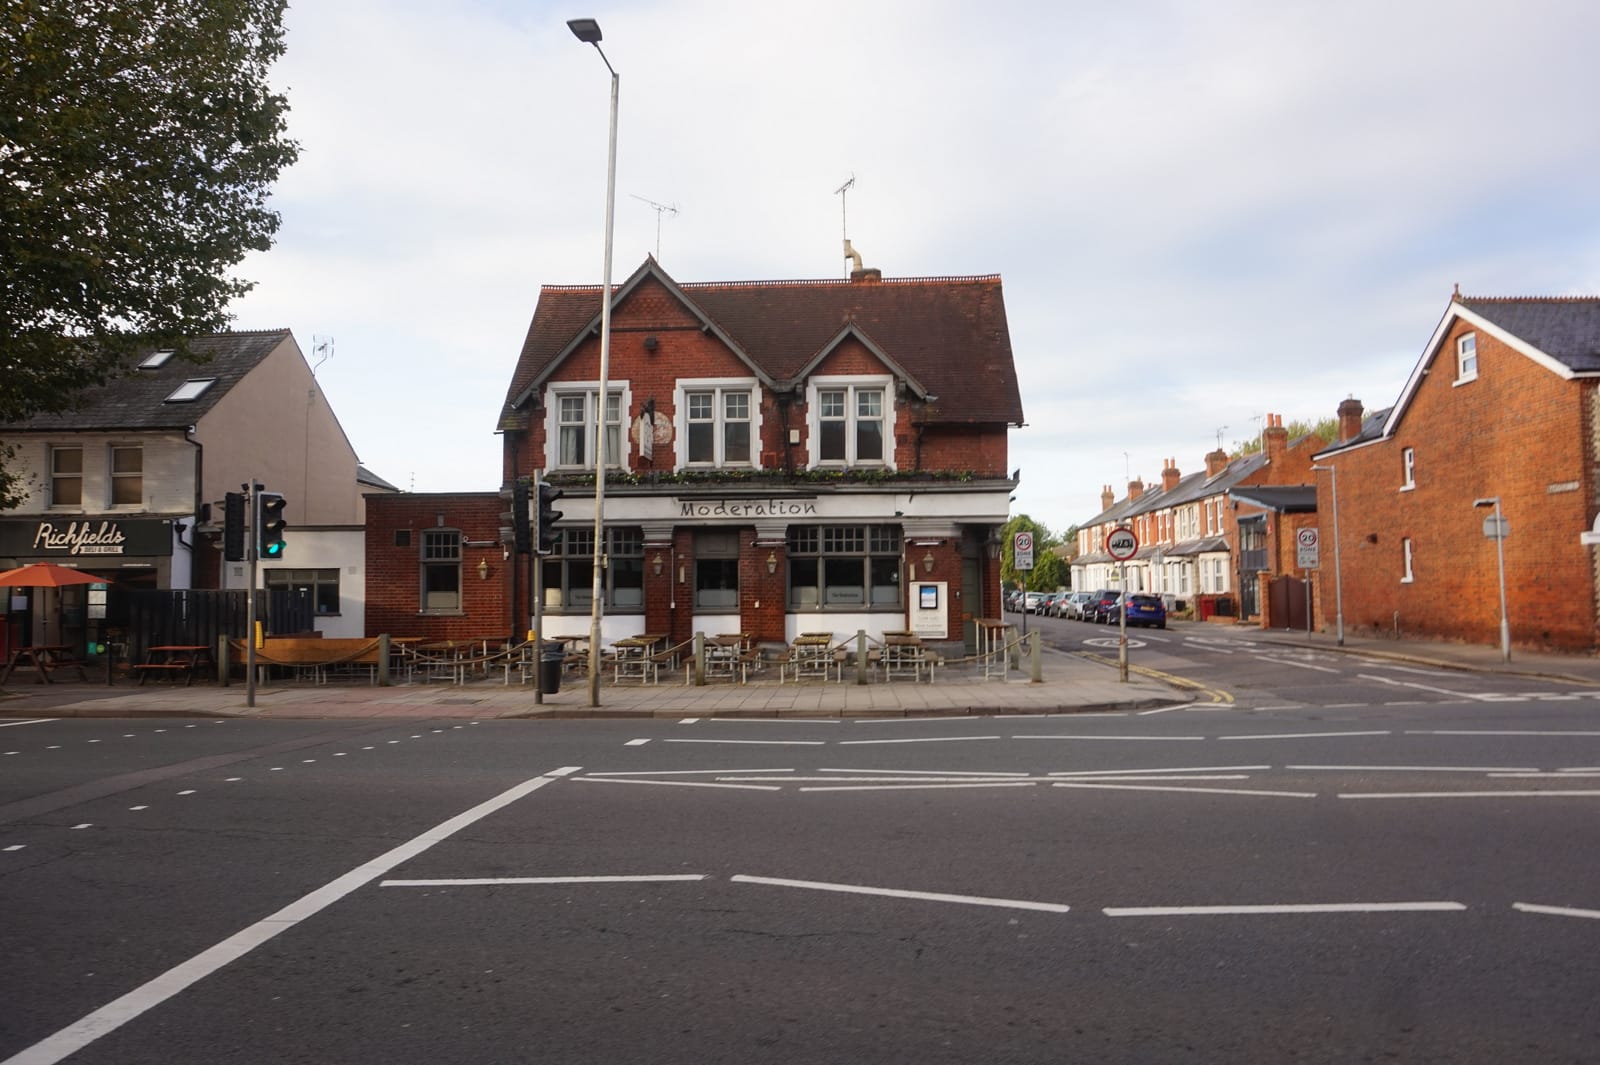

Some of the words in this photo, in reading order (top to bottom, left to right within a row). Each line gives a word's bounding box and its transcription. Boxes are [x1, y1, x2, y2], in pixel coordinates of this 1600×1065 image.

[680, 500, 817, 516] Moderation
[33, 521, 126, 555] Richfields
[1018, 538, 1030, 546] 20
[1302, 534, 1315, 542] 20
